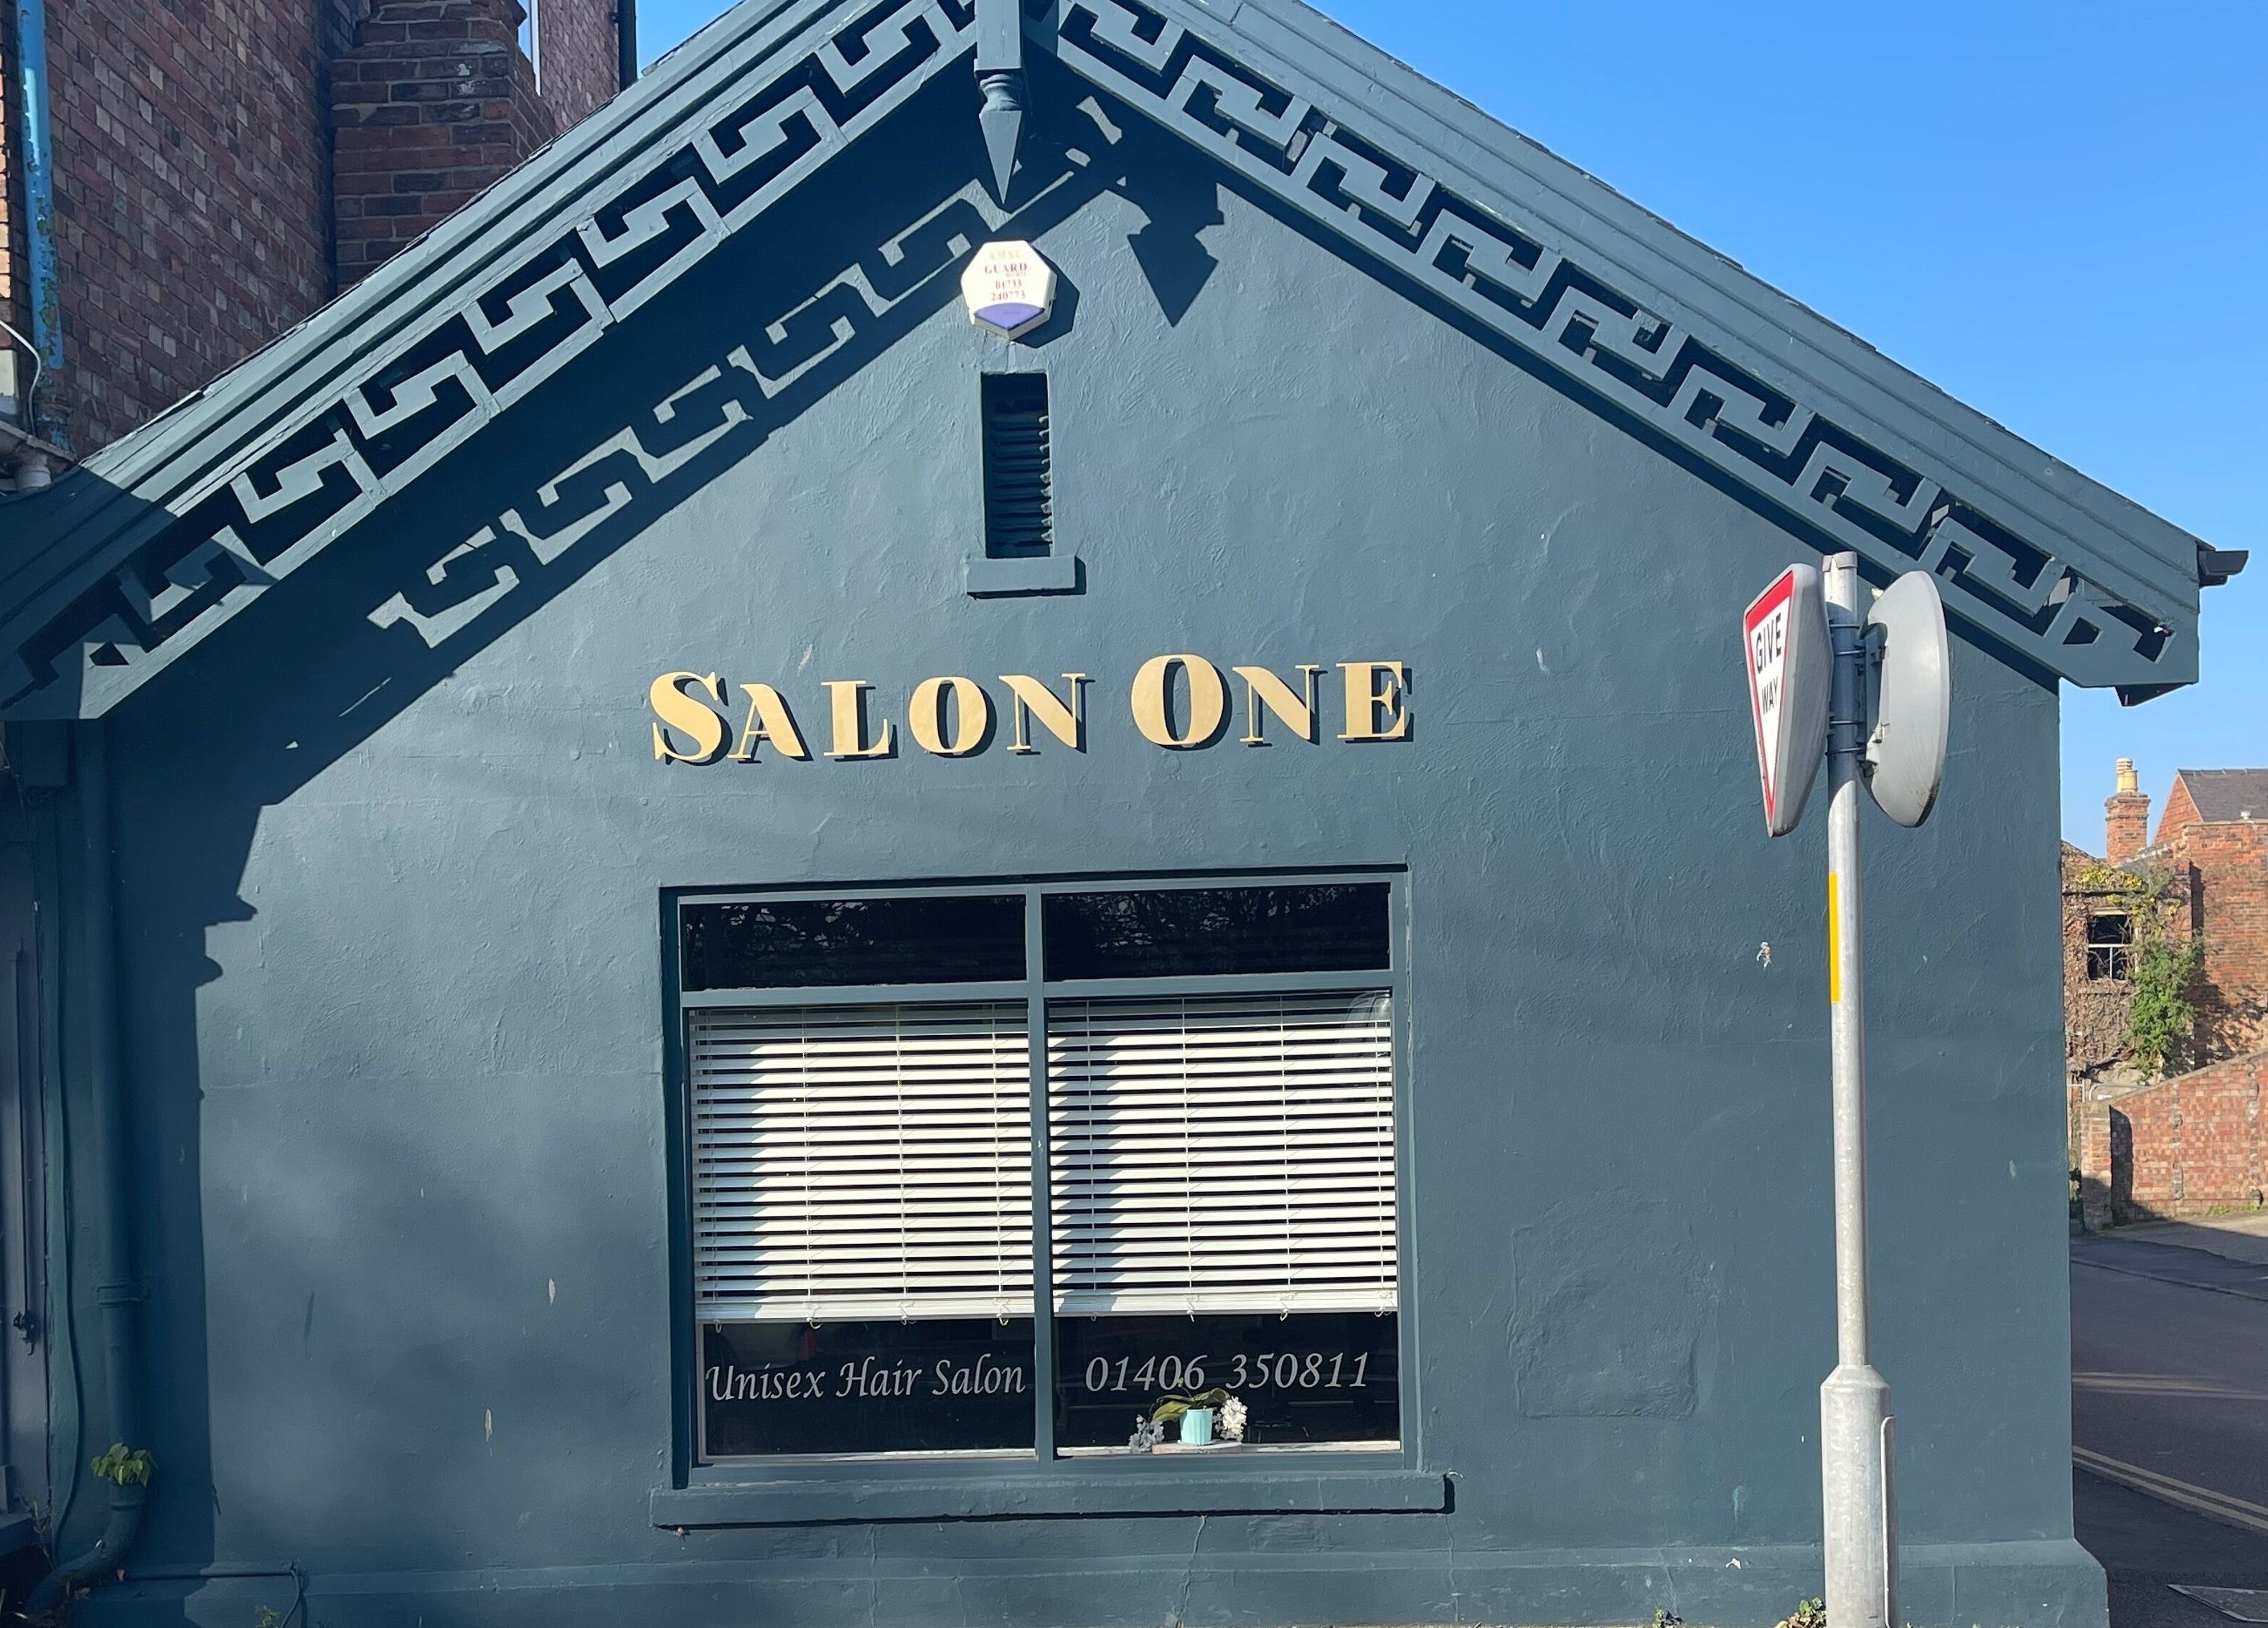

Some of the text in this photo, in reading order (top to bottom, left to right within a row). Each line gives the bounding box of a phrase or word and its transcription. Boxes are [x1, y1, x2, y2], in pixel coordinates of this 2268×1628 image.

[984, 262, 1028, 274] GUARD
[1756, 612, 1781, 675] GIVE
[1131, 654, 1406, 747] ONE
[1761, 676, 1779, 716] WAY
[705, 1352, 1026, 1401] Unisex Hair Salon
[1086, 1352, 1369, 1393] 01406 350811
